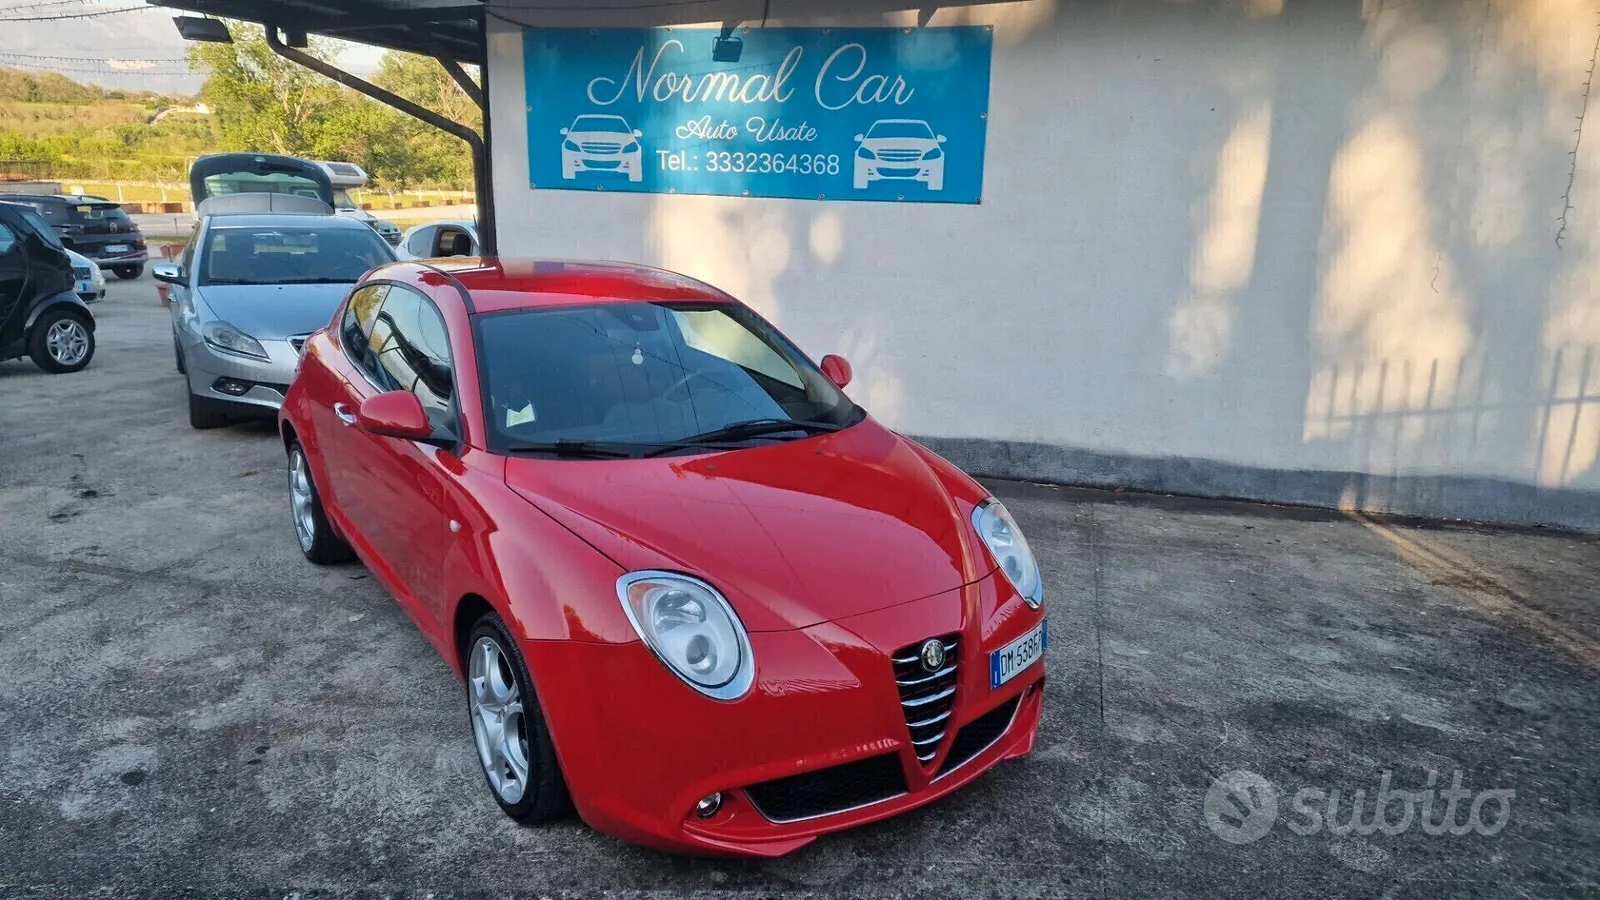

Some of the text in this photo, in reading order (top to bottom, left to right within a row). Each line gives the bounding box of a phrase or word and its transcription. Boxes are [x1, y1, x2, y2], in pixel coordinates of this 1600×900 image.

[587, 39, 915, 110] Normal Car
[675, 114, 818, 142] Auto Usate
[655, 149, 840, 175] Tel.: 3332364368
[1001, 650, 1014, 676] DM
